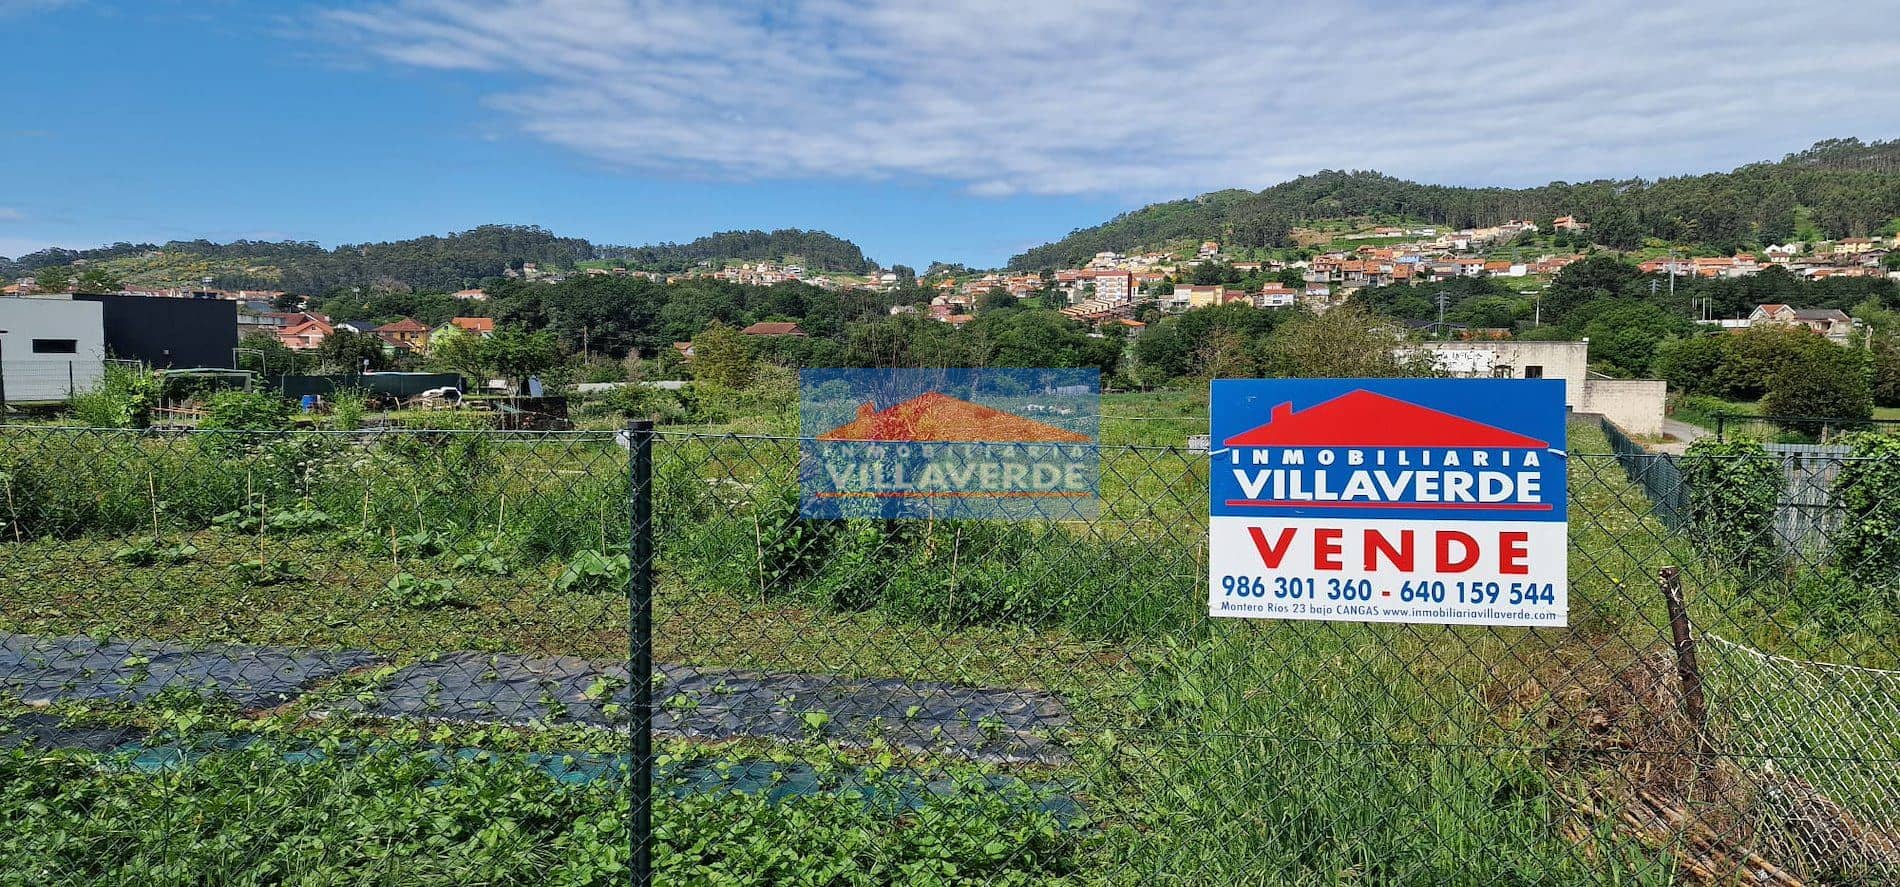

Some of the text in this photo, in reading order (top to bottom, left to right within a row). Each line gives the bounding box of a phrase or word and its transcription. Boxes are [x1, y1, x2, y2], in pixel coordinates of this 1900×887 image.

[1231, 449, 1540, 466] INMOBILIARIA
[1232, 469, 1541, 503] VILLAVERDE
[1247, 527, 1529, 575] VENDE
[1222, 576, 1265, 598] 986
[1274, 577, 1315, 599] 301
[1327, 578, 1372, 601] 360
[1400, 580, 1446, 603] 640
[1456, 582, 1500, 604] 159
[1509, 583, 1555, 605] 544
[1220, 601, 1264, 612] Montero
[1292, 603, 1306, 613] 23
[1310, 603, 1333, 616] bajo
[1336, 604, 1379, 616] CANGAS
[1382, 607, 1557, 620] www.inmobiliariavillaverde.com
